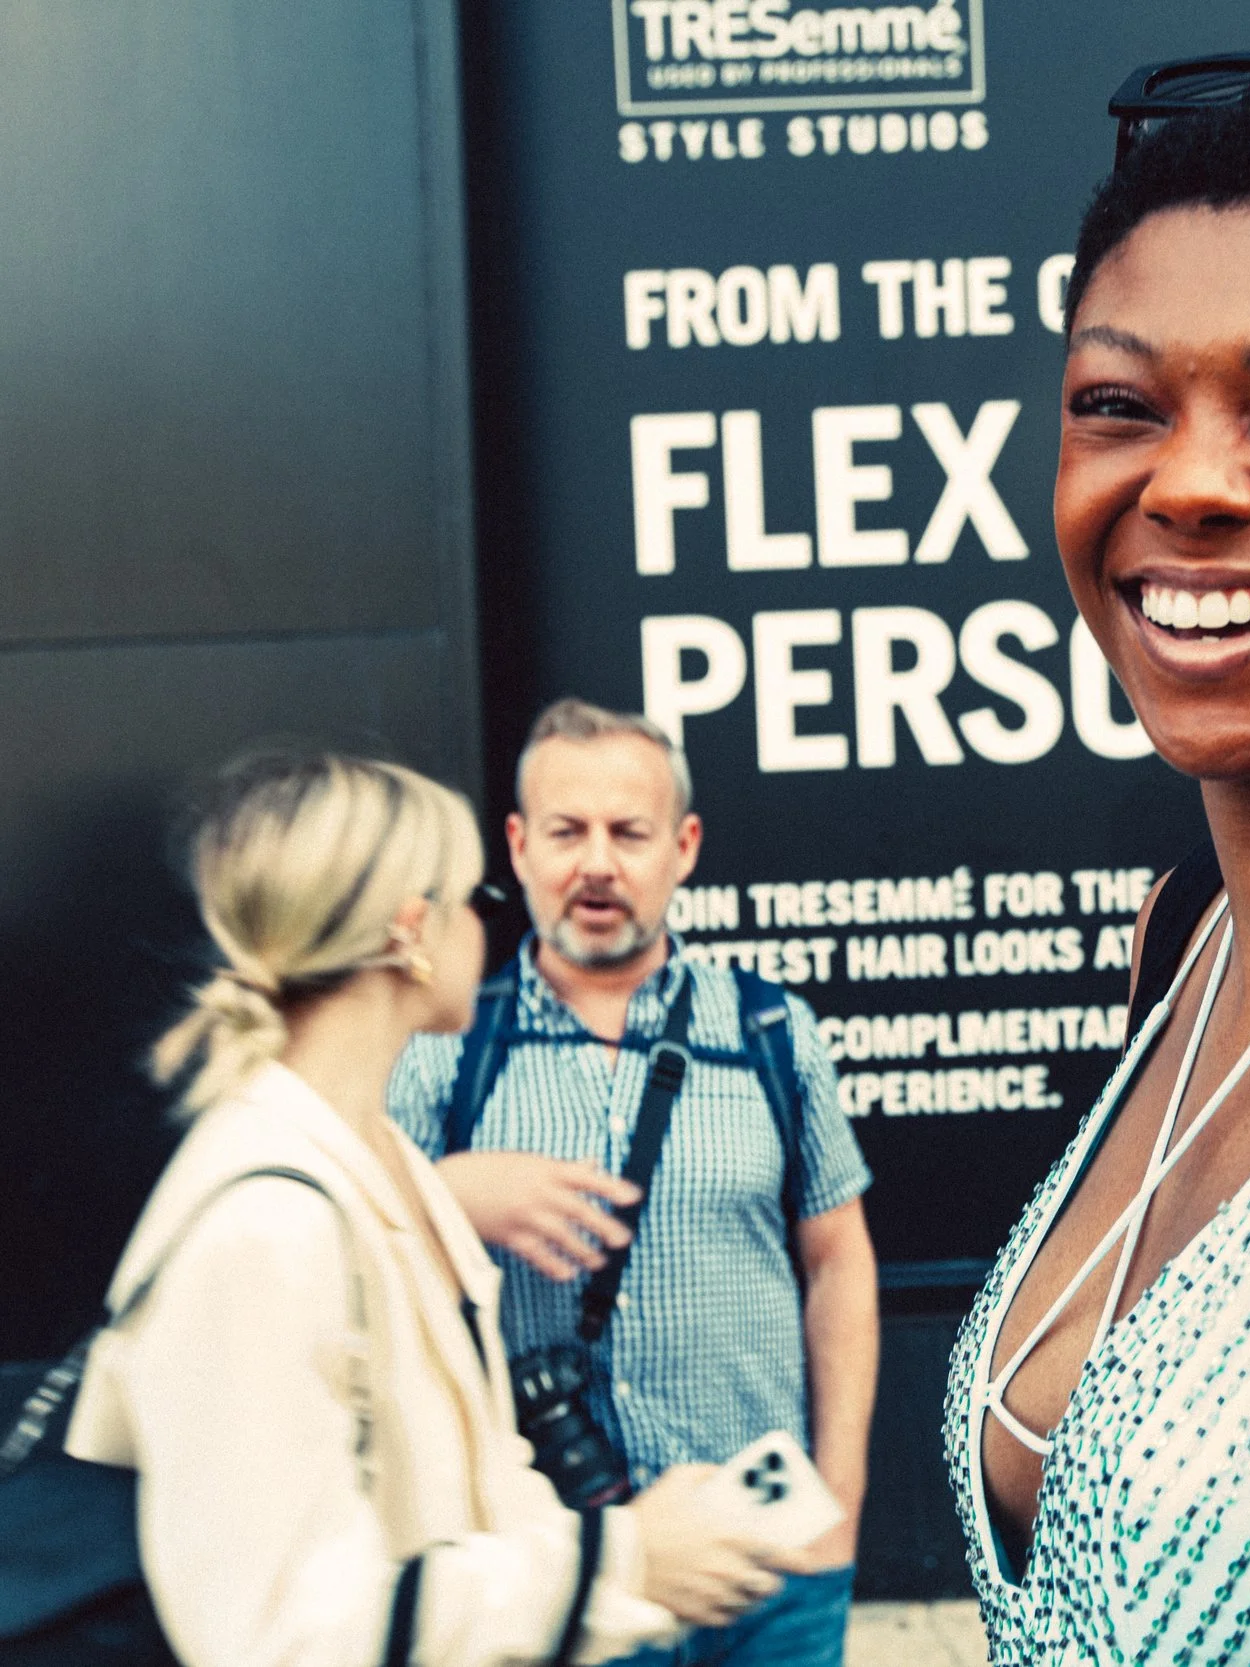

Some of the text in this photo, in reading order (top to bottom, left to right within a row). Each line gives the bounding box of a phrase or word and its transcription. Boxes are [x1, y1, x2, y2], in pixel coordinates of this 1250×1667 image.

[631, 0, 966, 60] TRESemmé
[618, 110, 989, 163] STYLE STUDIOS
[624, 263, 841, 350] FROM
[862, 256, 1015, 340] THE
[630, 400, 1030, 576] FLEX
[666, 866, 1154, 933] OIN TRESEMMÉ FOR THE
[846, 931, 947, 981] HAIR
[954, 927, 1085, 976] LOOKS
[817, 1005, 1129, 1062] COMPLIMENTAR
